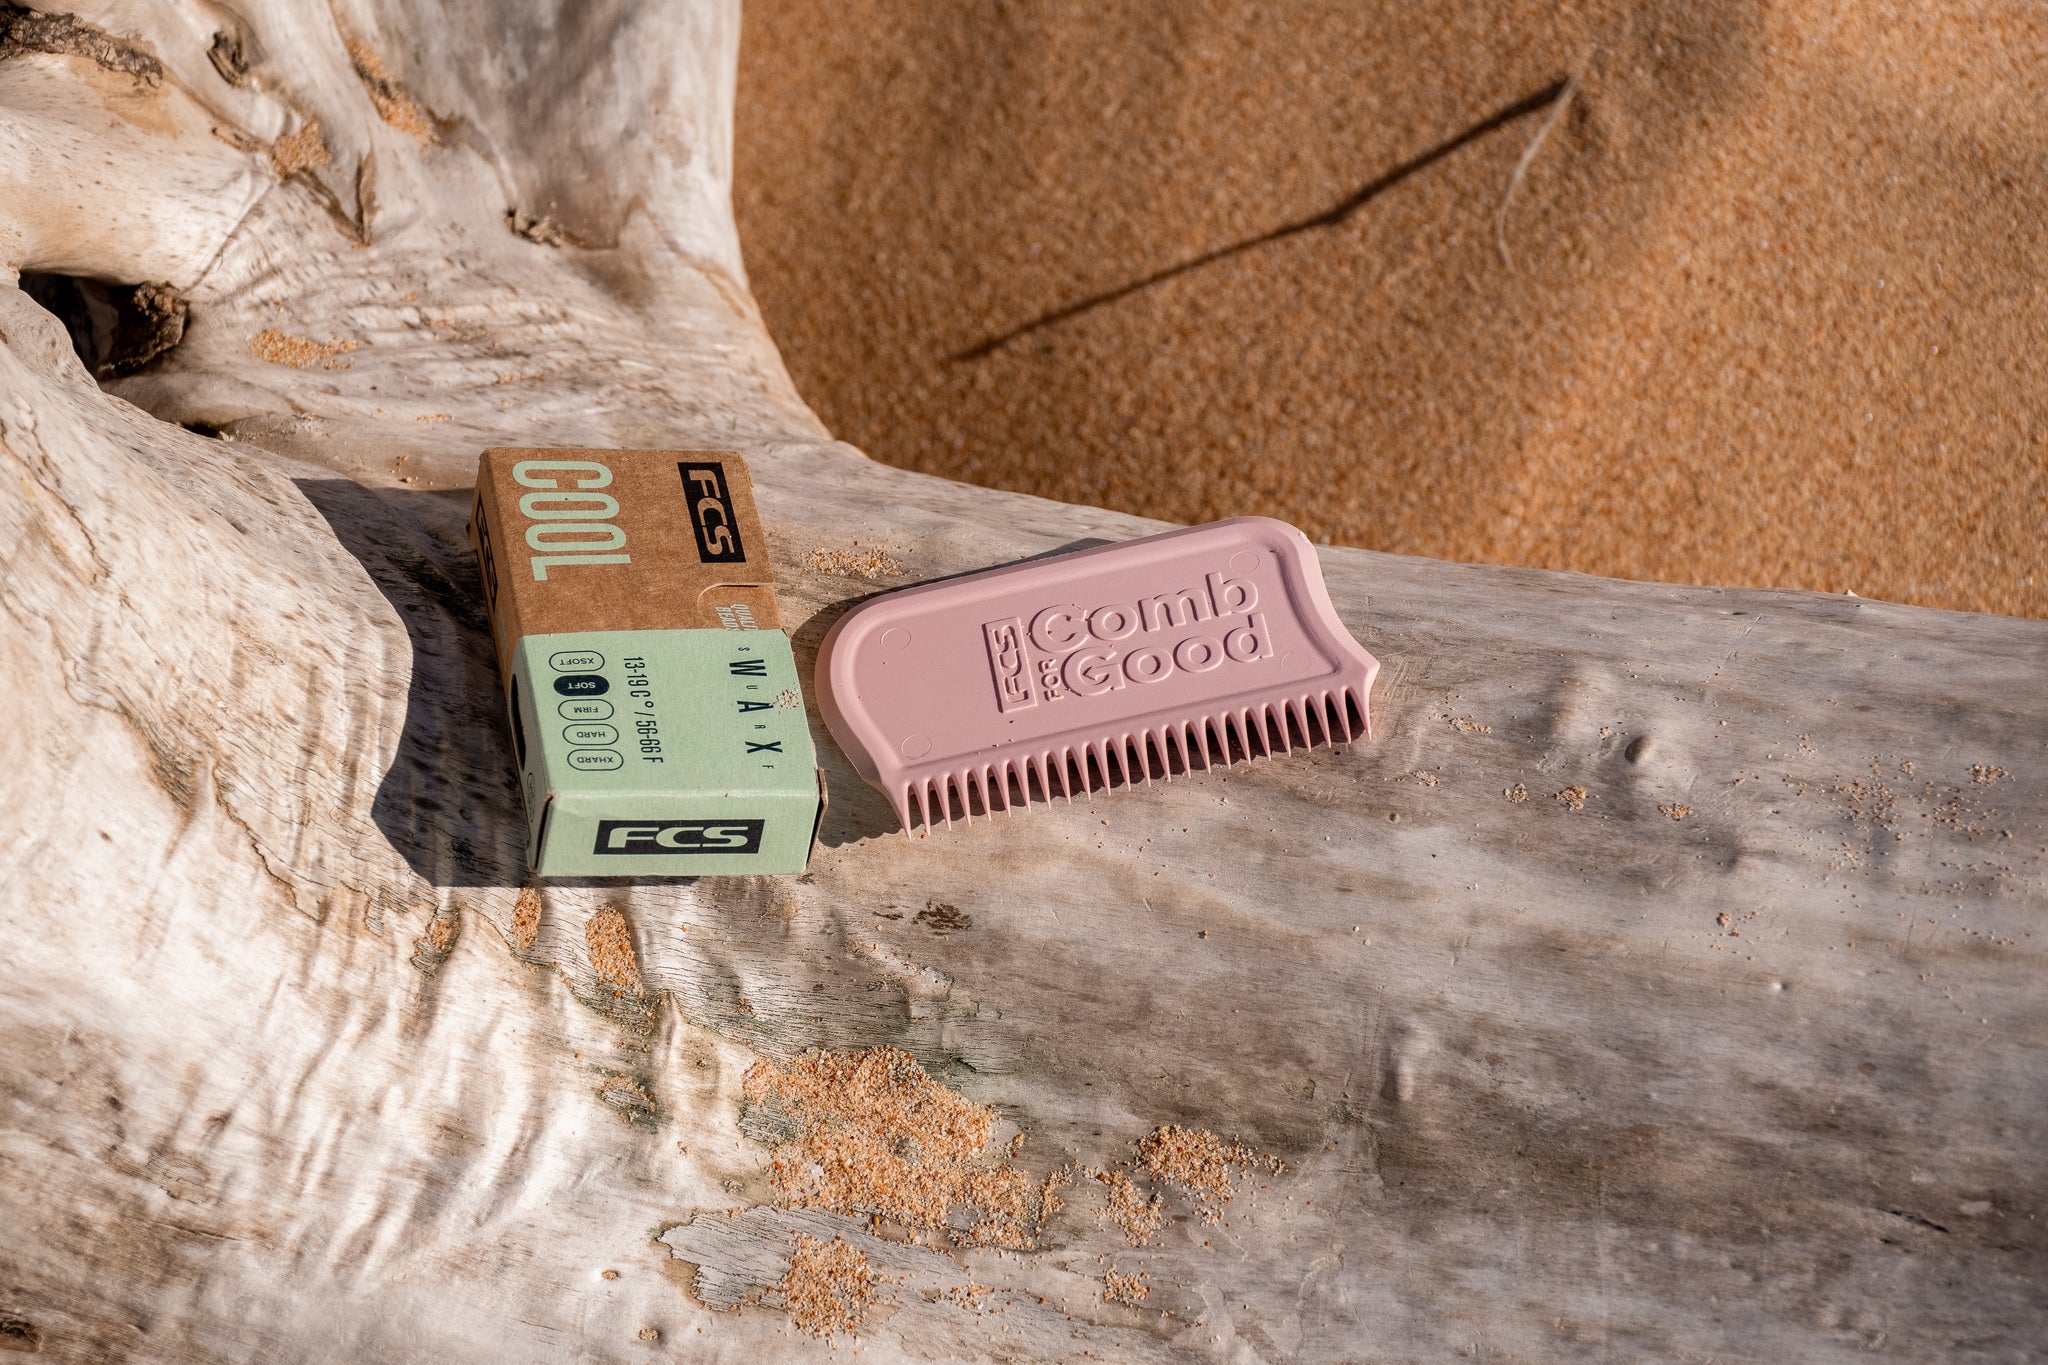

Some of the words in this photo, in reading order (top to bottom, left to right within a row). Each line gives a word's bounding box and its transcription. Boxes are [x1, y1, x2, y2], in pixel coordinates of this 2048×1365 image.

[512, 460, 632, 581] COOL
[688, 468, 736, 557] FCS
[1028, 571, 1260, 653] Comb
[559, 657, 595, 666] XSOFT
[991, 623, 1031, 704] FCS
[1060, 612, 1275, 697] Good
[567, 681, 597, 690] SOFT
[623, 656, 649, 687] 13-19
[1038, 658, 1065, 702] FOR
[573, 706, 599, 714] FIRM
[576, 731, 606, 739] HARD
[635, 720, 662, 753] 56-66
[576, 756, 614, 764] XHARD
[607, 826, 749, 849] FCS
